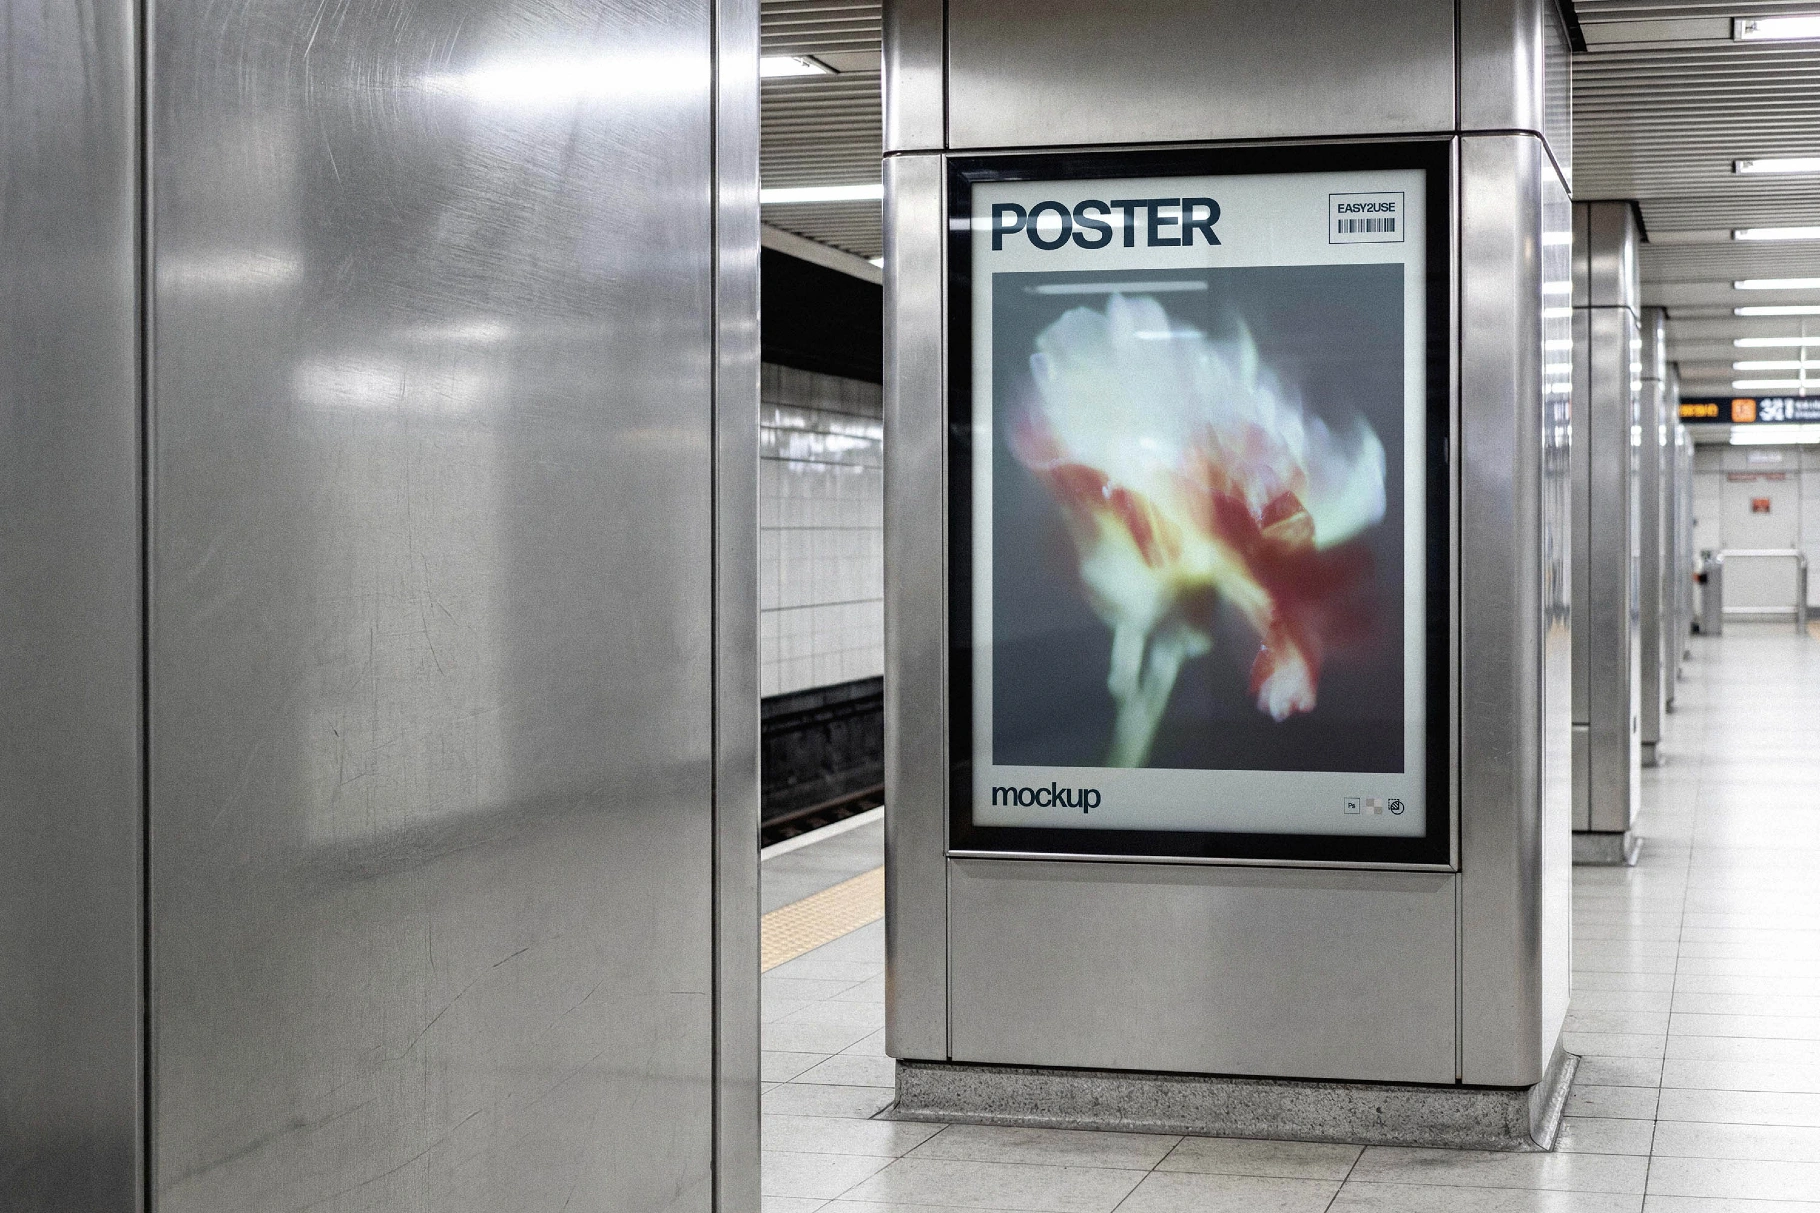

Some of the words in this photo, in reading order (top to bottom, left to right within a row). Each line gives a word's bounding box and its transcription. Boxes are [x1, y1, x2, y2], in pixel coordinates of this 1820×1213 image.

[1338, 202, 1396, 213] EASY2USE
[992, 198, 1222, 251] POSTER
[992, 782, 1101, 814] mockup
